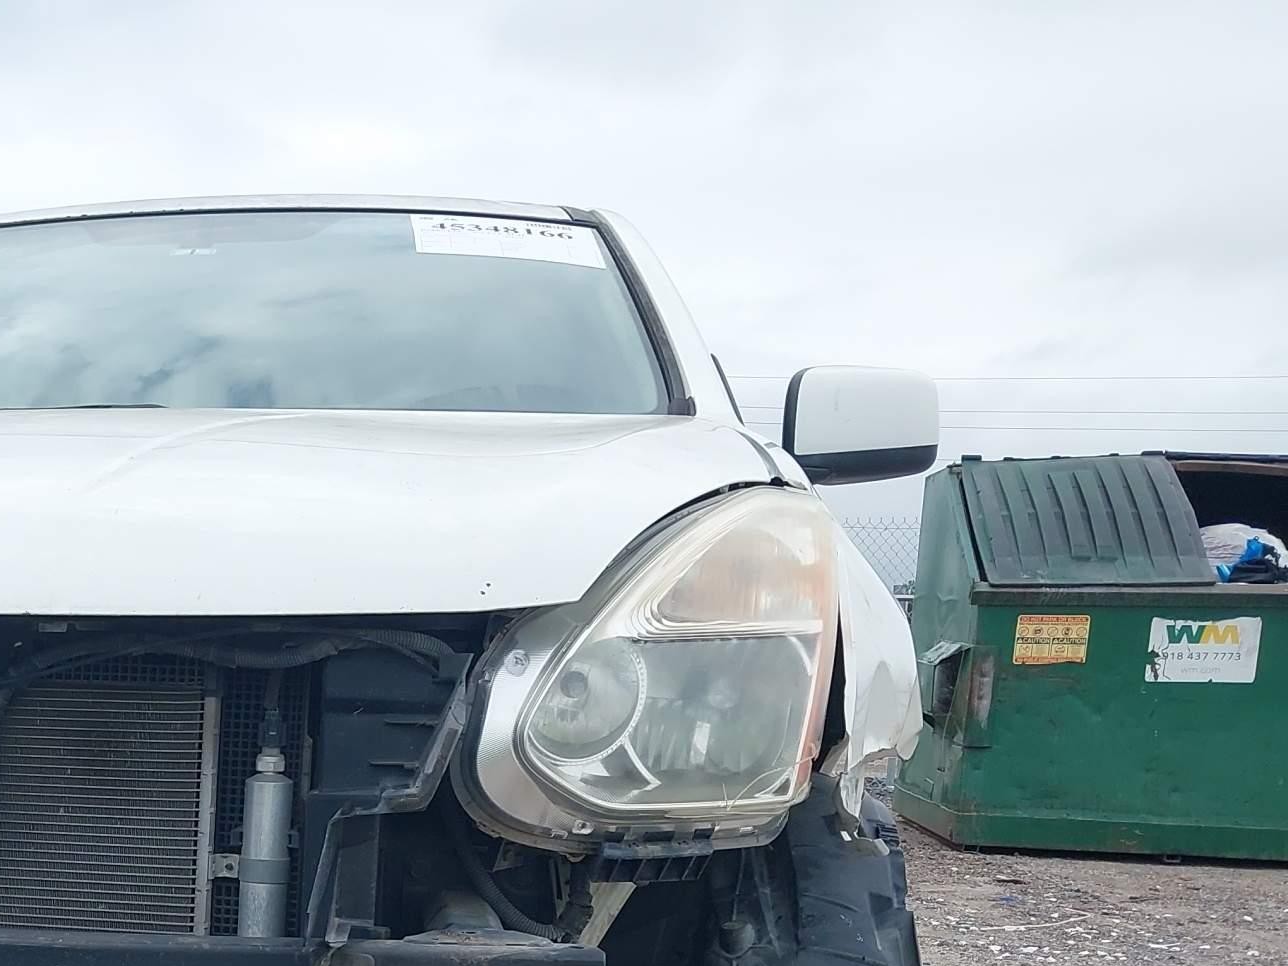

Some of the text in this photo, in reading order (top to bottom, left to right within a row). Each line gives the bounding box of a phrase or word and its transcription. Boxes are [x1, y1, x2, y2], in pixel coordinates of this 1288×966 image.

[431, 222, 573, 240] 45348166
[1166, 624, 1240, 644] WM
[1163, 651, 1241, 661] 918 437 7773
